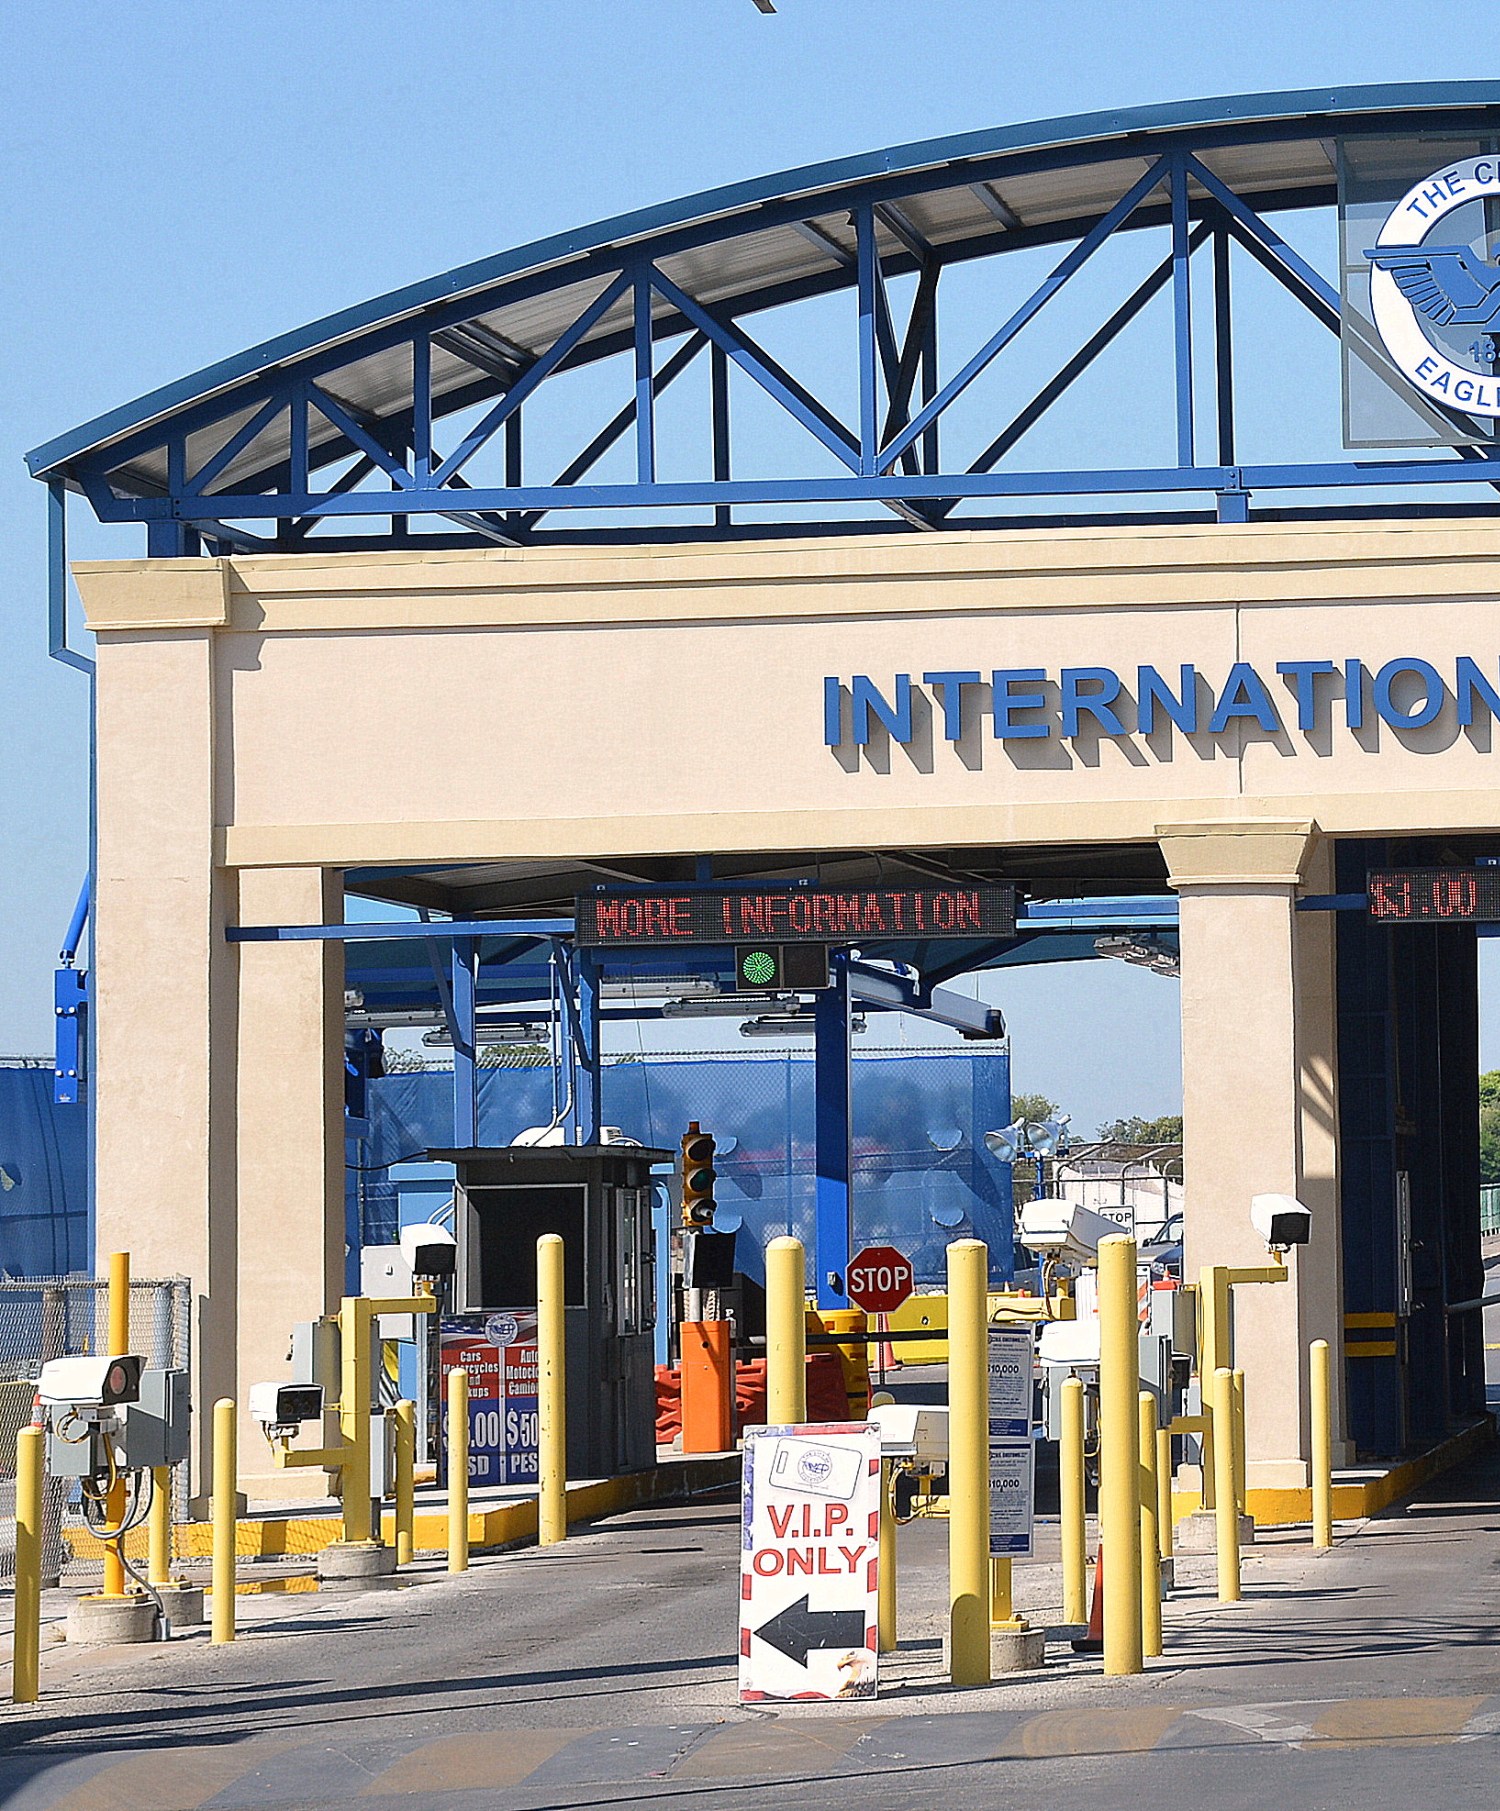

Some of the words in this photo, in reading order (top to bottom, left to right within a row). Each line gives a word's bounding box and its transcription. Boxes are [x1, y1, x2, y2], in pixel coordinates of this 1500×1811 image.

[1406, 170, 1465, 219] THE
[595, 897, 693, 936] MORE
[722, 892, 982, 934] INFORMATION
[851, 1266, 909, 1293] STOP
[443, 1362, 499, 1375] Mrcycles
[460, 1351, 481, 1362] Cars
[469, 1374, 480, 1385] nd
[443, 1411, 499, 1452] $.00
[468, 1455, 489, 1476] SD
[511, 1453, 538, 1473] PES
[767, 1503, 853, 1538] V.I.P.
[753, 1546, 867, 1576] ONLY
